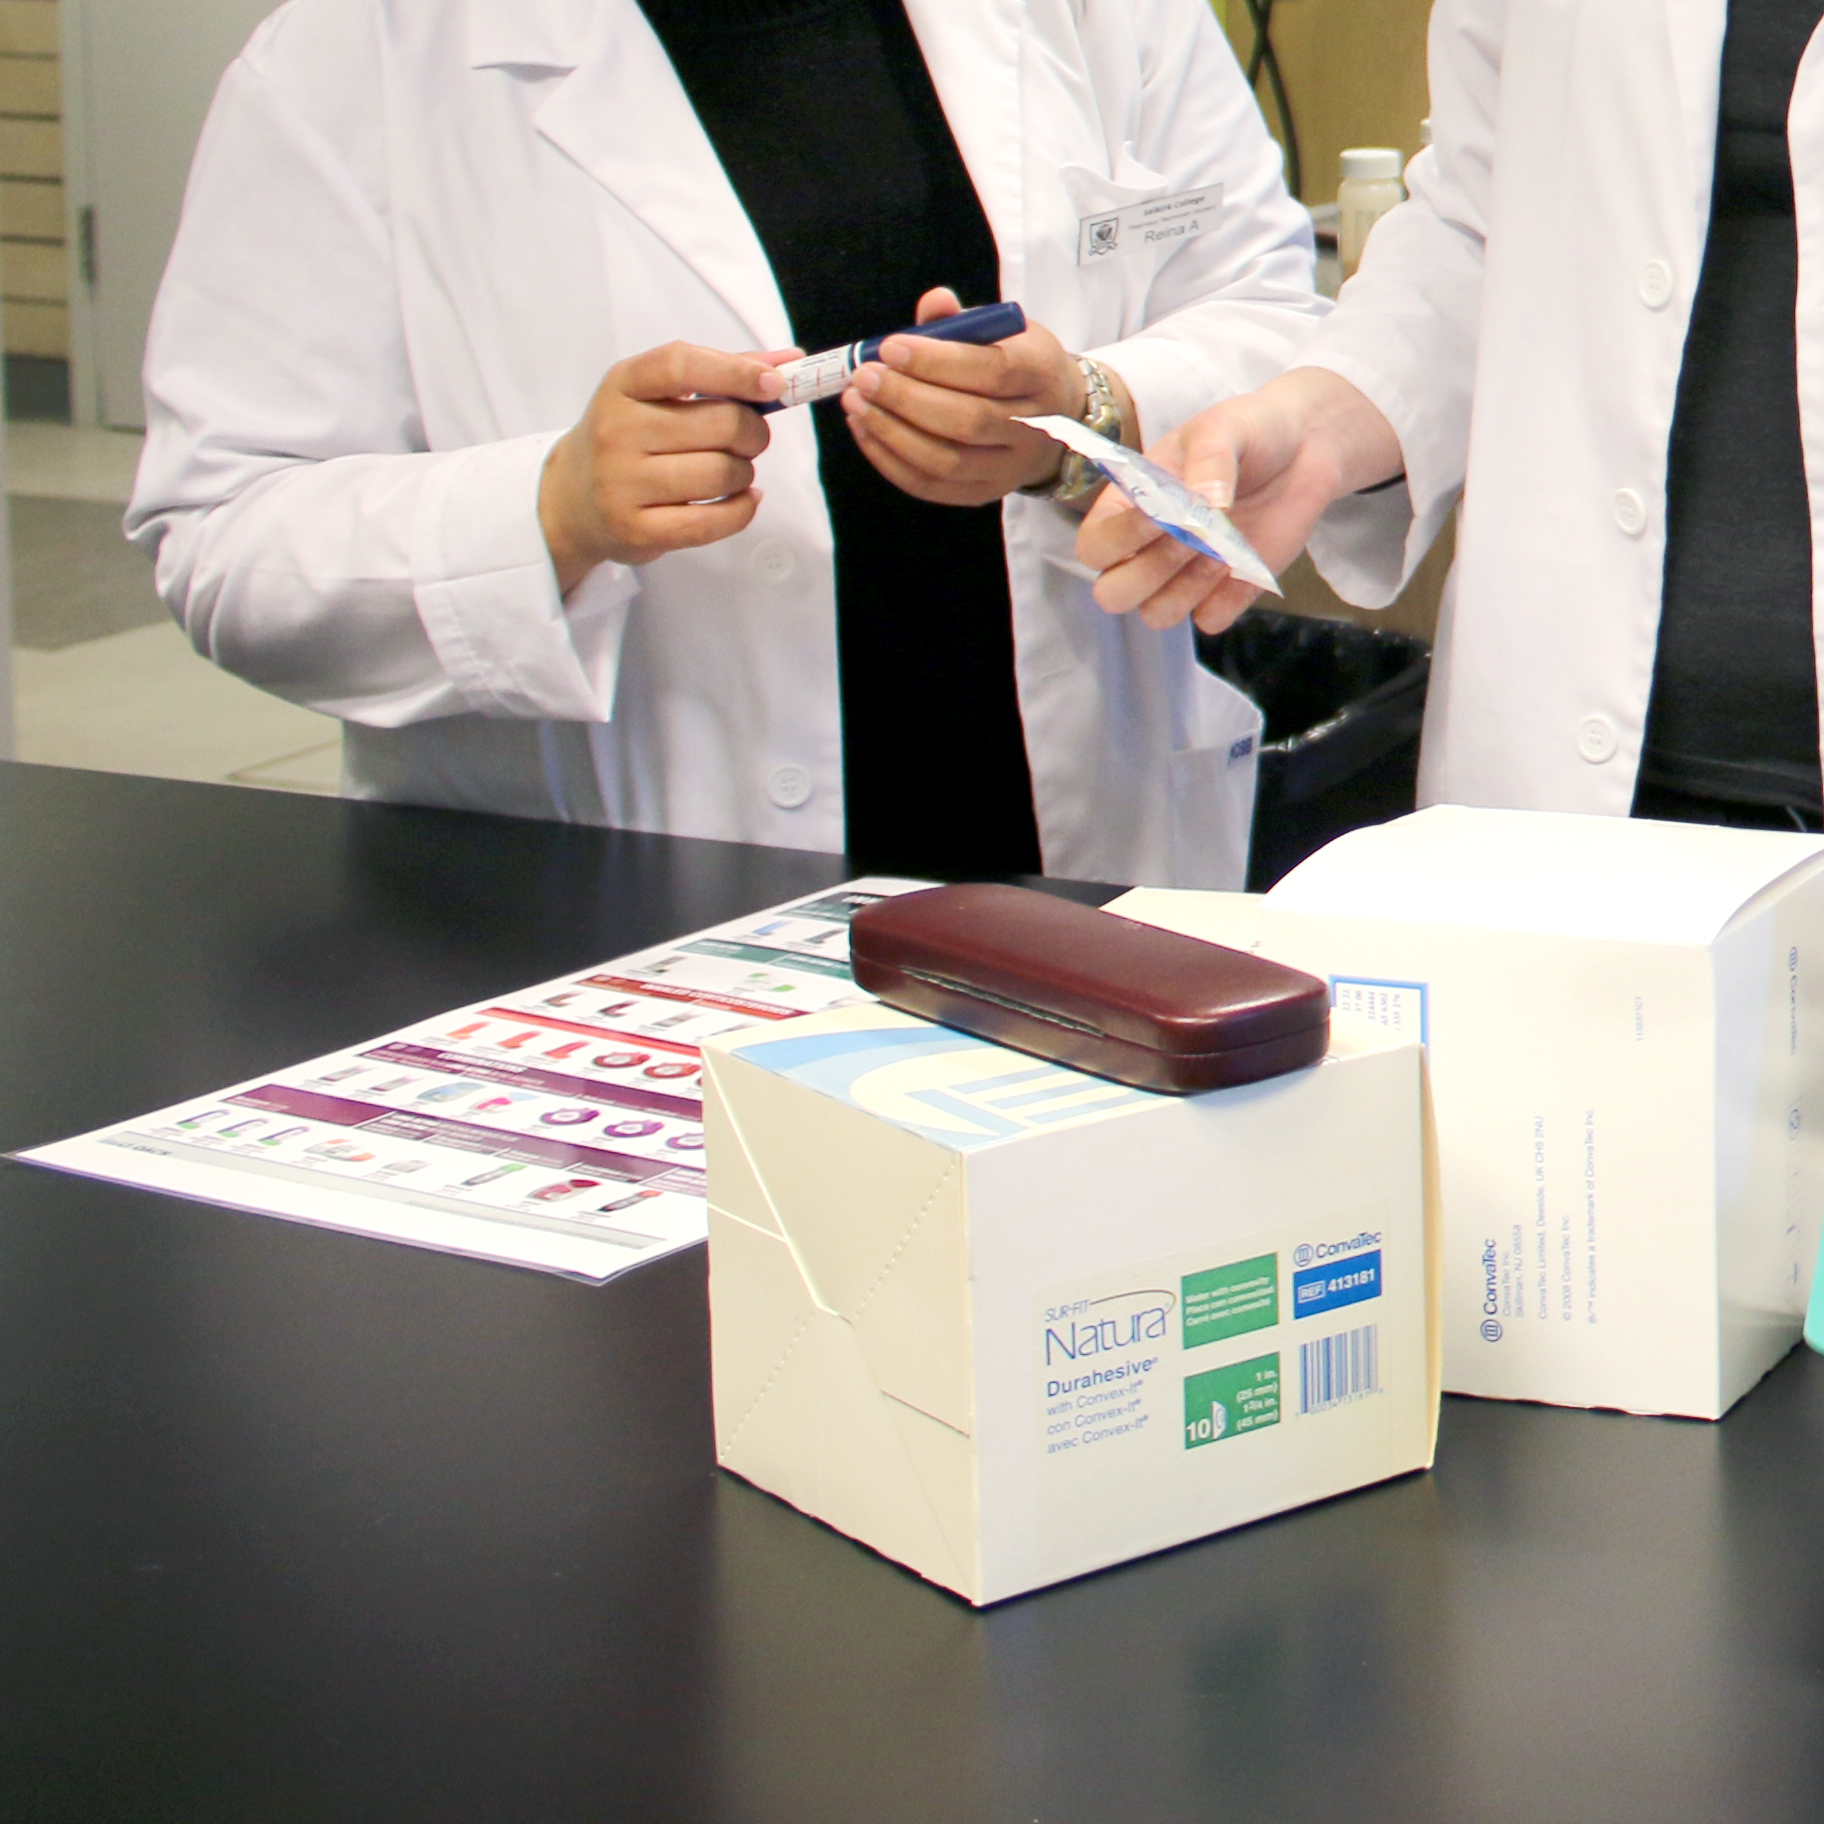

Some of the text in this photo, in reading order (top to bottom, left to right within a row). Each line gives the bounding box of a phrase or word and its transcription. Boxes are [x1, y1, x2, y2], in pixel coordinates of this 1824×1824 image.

[1535, 1165, 1544, 1181] UK
[1316, 1232, 1382, 1259] ConvaTec
[1514, 1257, 1523, 1272] NJ
[1300, 1268, 1375, 1300] REF 413181
[1482, 1238, 1497, 1315] ConvaTec
[1045, 1299, 1090, 1323] SUR-FIT
[1047, 1401, 1072, 1417] with
[1047, 1420, 1071, 1435] con
[1186, 1418, 1211, 1442] 10
[1047, 1438, 1078, 1455] avec
